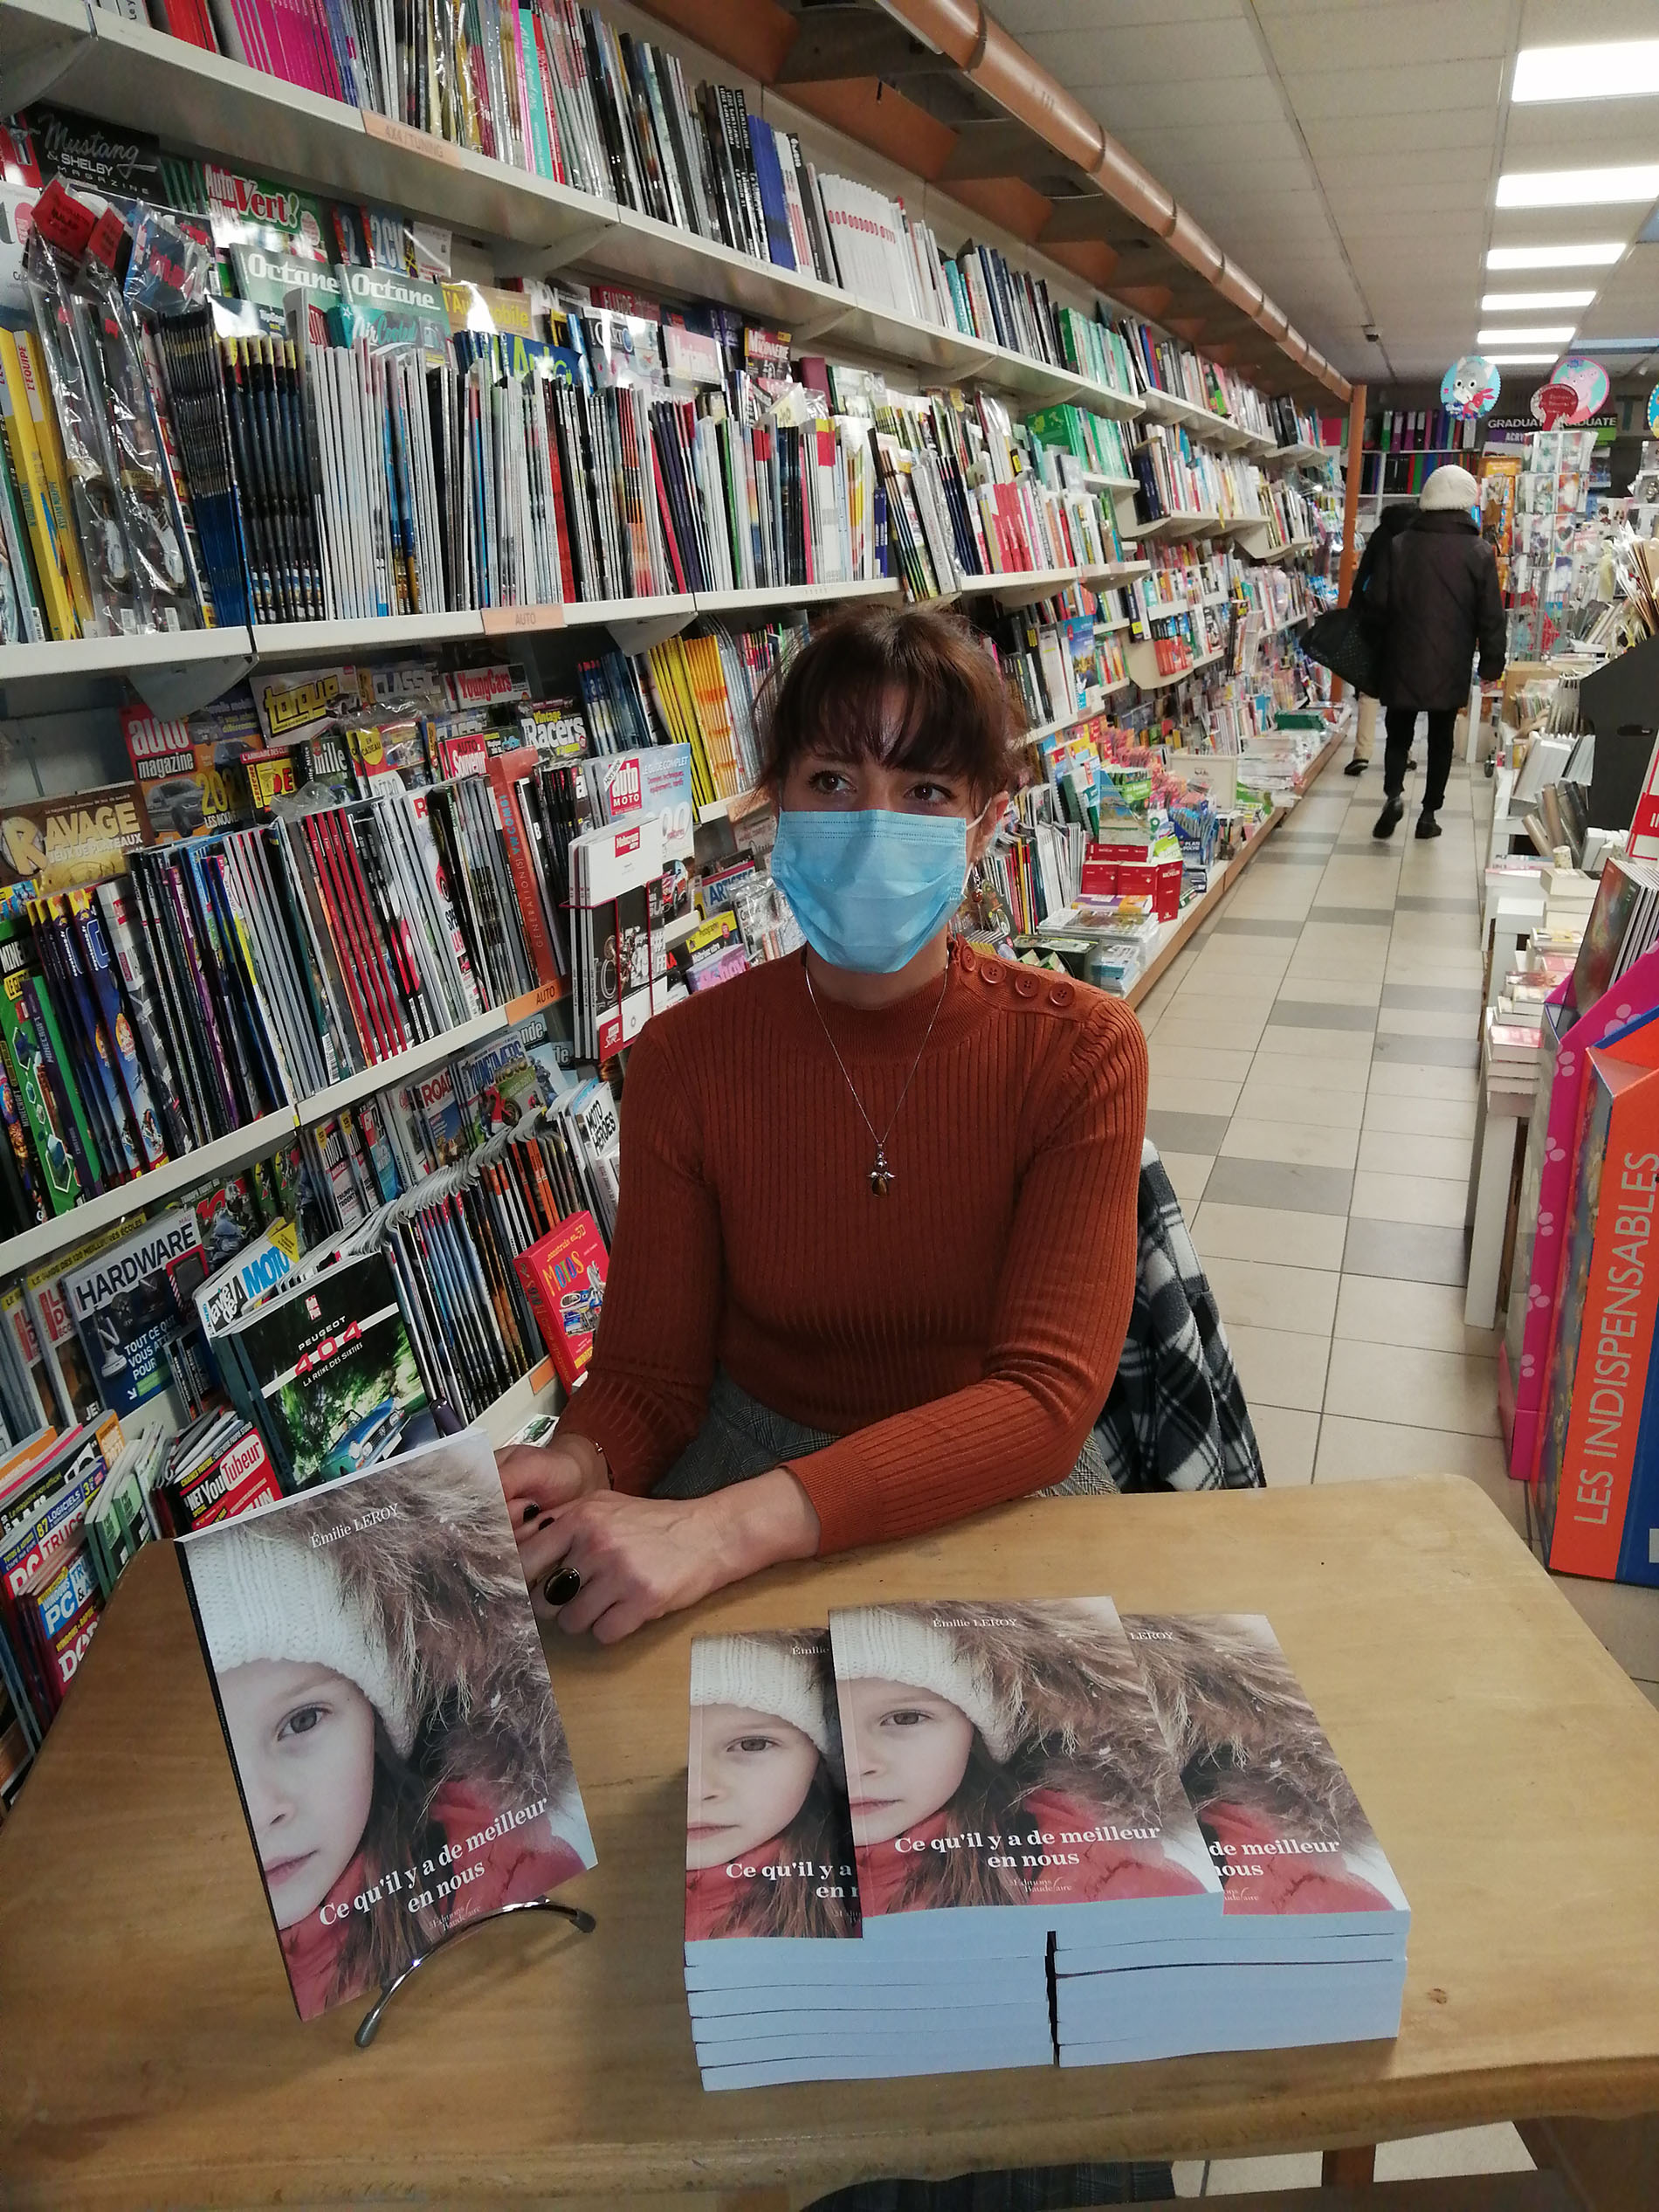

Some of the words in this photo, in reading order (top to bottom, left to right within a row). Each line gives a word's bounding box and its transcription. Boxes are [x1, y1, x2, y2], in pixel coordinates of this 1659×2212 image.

[40, 114, 150, 176] Mustang
[57, 165, 150, 195] MAGAZINE
[61, 153, 114, 176] SHELBY
[233, 175, 299, 229] Vert!
[247, 252, 341, 294] Octane
[351, 272, 440, 311] Octane
[515, 612, 536, 625] AUTO
[458, 669, 513, 701] YoungCars
[520, 716, 587, 751] Racers
[533, 710, 562, 725] Vintage
[128, 716, 189, 757] auto
[361, 742, 382, 756] CADEAU
[457, 739, 478, 755] AUTO
[137, 751, 194, 780] magazine
[313, 741, 348, 775] mille
[611, 762, 639, 798] auto
[613, 793, 640, 807] MOTO
[49, 844, 75, 865] JEUX
[535, 984, 556, 1006] AUTO
[586, 1098, 602, 1132] MOTO
[593, 1111, 616, 1157] HEROES
[76, 1222, 197, 1311] HARDWARE
[241, 1245, 291, 1299] MOTO
[1584, 1151, 1659, 1462] INDISPENSABLES
[124, 1331, 148, 1355] TOUT
[148, 1324, 161, 1339] CE
[294, 1320, 363, 1376] 404
[298, 1315, 347, 1351] PEUGEOT
[127, 1346, 154, 1368] VOUS
[132, 1357, 159, 1382] POUR
[302, 1376, 313, 1388] LA
[312, 1364, 330, 1381] REINE
[330, 1355, 342, 1368] DES
[341, 1341, 364, 1361] SIXTIES
[1573, 1466, 1614, 1526] LES
[37, 1518, 48, 1539] 87
[47, 1489, 80, 1524] LOGICIELS
[310, 1524, 351, 1549] Émilie
[354, 1502, 399, 1533] LEROY
[9, 1553, 40, 1596] PC
[45, 1590, 75, 1636] PC
[77, 1587, 86, 1602] &
[933, 1617, 971, 1628] Émilie
[974, 1617, 1018, 1628] LEROY
[792, 1645, 830, 1657] Émilie
[1130, 1630, 1174, 1642] LEROY
[894, 1836, 926, 1854] Ce
[930, 1832, 984, 1857] qu'il
[987, 1836, 1003, 1851] y
[1007, 1831, 1023, 1847] a
[1026, 1828, 1057, 1846] de
[1060, 1824, 1161, 1844] meilleur
[1208, 1840, 1238, 1857] de
[1243, 1838, 1341, 1857] meilleur
[318, 1900, 351, 1927] Ce
[353, 1870, 403, 1917] qu'il
[404, 1869, 419, 1891] y
[421, 1858, 437, 1878] a
[438, 1842, 464, 1869] de
[465, 1797, 548, 1852] meilleur
[726, 1862, 757, 1879] Ce
[761, 1860, 814, 1882] qu'il
[818, 1866, 834, 1880] y
[839, 1864, 853, 1878] a
[987, 1854, 1019, 1869] en
[1022, 1850, 1081, 1867] nous
[407, 1891, 435, 1915] en
[435, 1861, 486, 1900] nous
[816, 1884, 845, 1898] en
